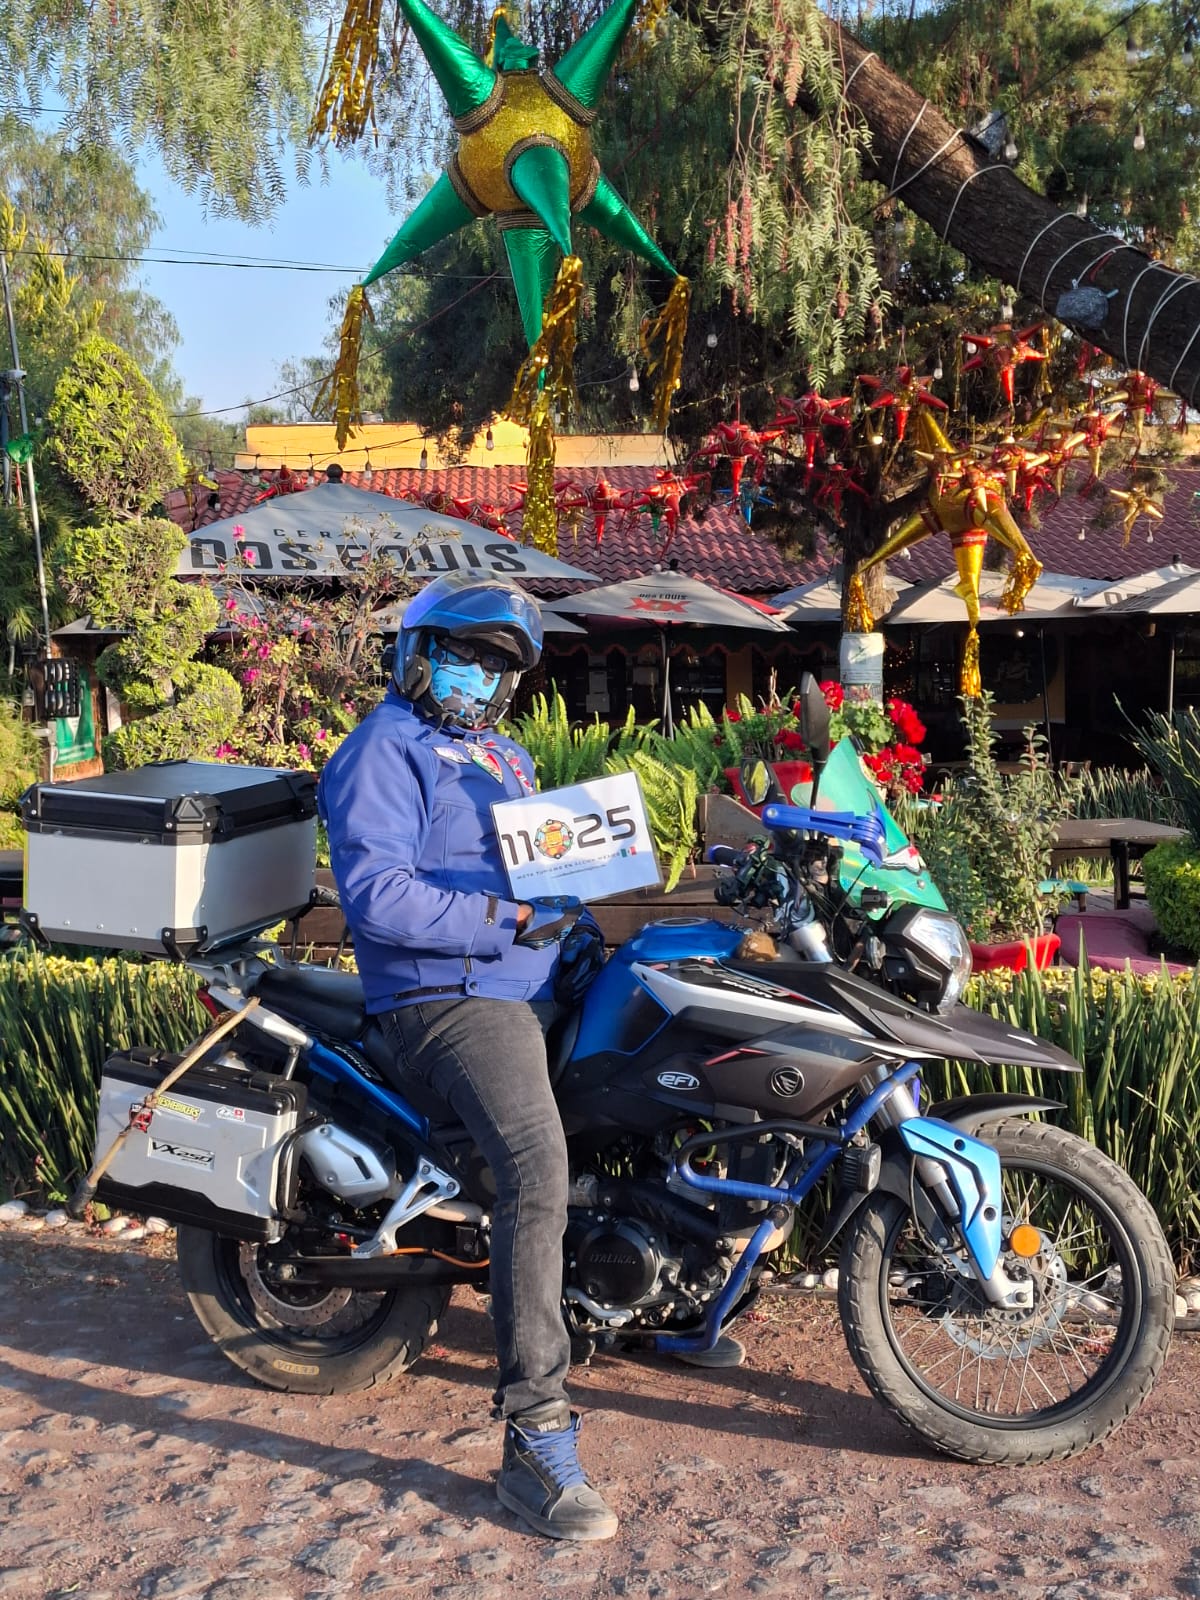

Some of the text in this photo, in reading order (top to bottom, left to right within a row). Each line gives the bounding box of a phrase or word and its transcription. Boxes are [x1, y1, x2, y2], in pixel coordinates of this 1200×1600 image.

[191, 537, 527, 572] DOS EQUIS
[152, 1141, 213, 1163] VX250
